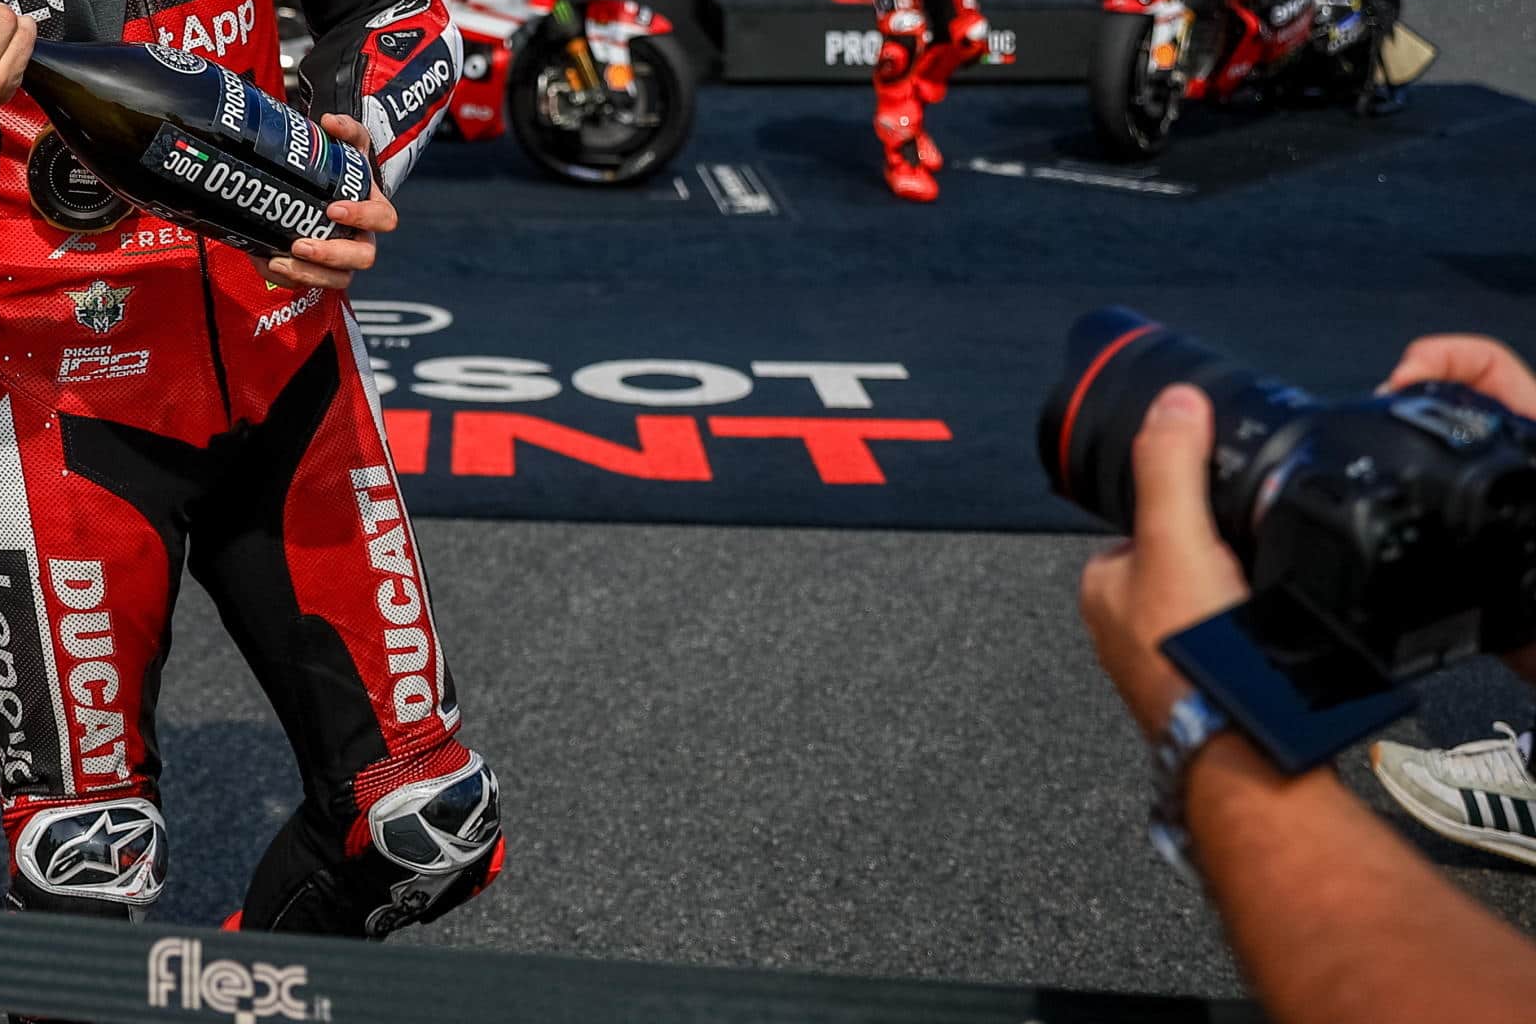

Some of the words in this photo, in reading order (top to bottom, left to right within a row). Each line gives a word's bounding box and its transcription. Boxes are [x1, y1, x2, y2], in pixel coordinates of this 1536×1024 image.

[387, 59, 450, 121] Lenovo
[164, 151, 204, 182] DOC
[253, 287, 323, 337] MotoGP
[350, 465, 434, 724] DUCATI
